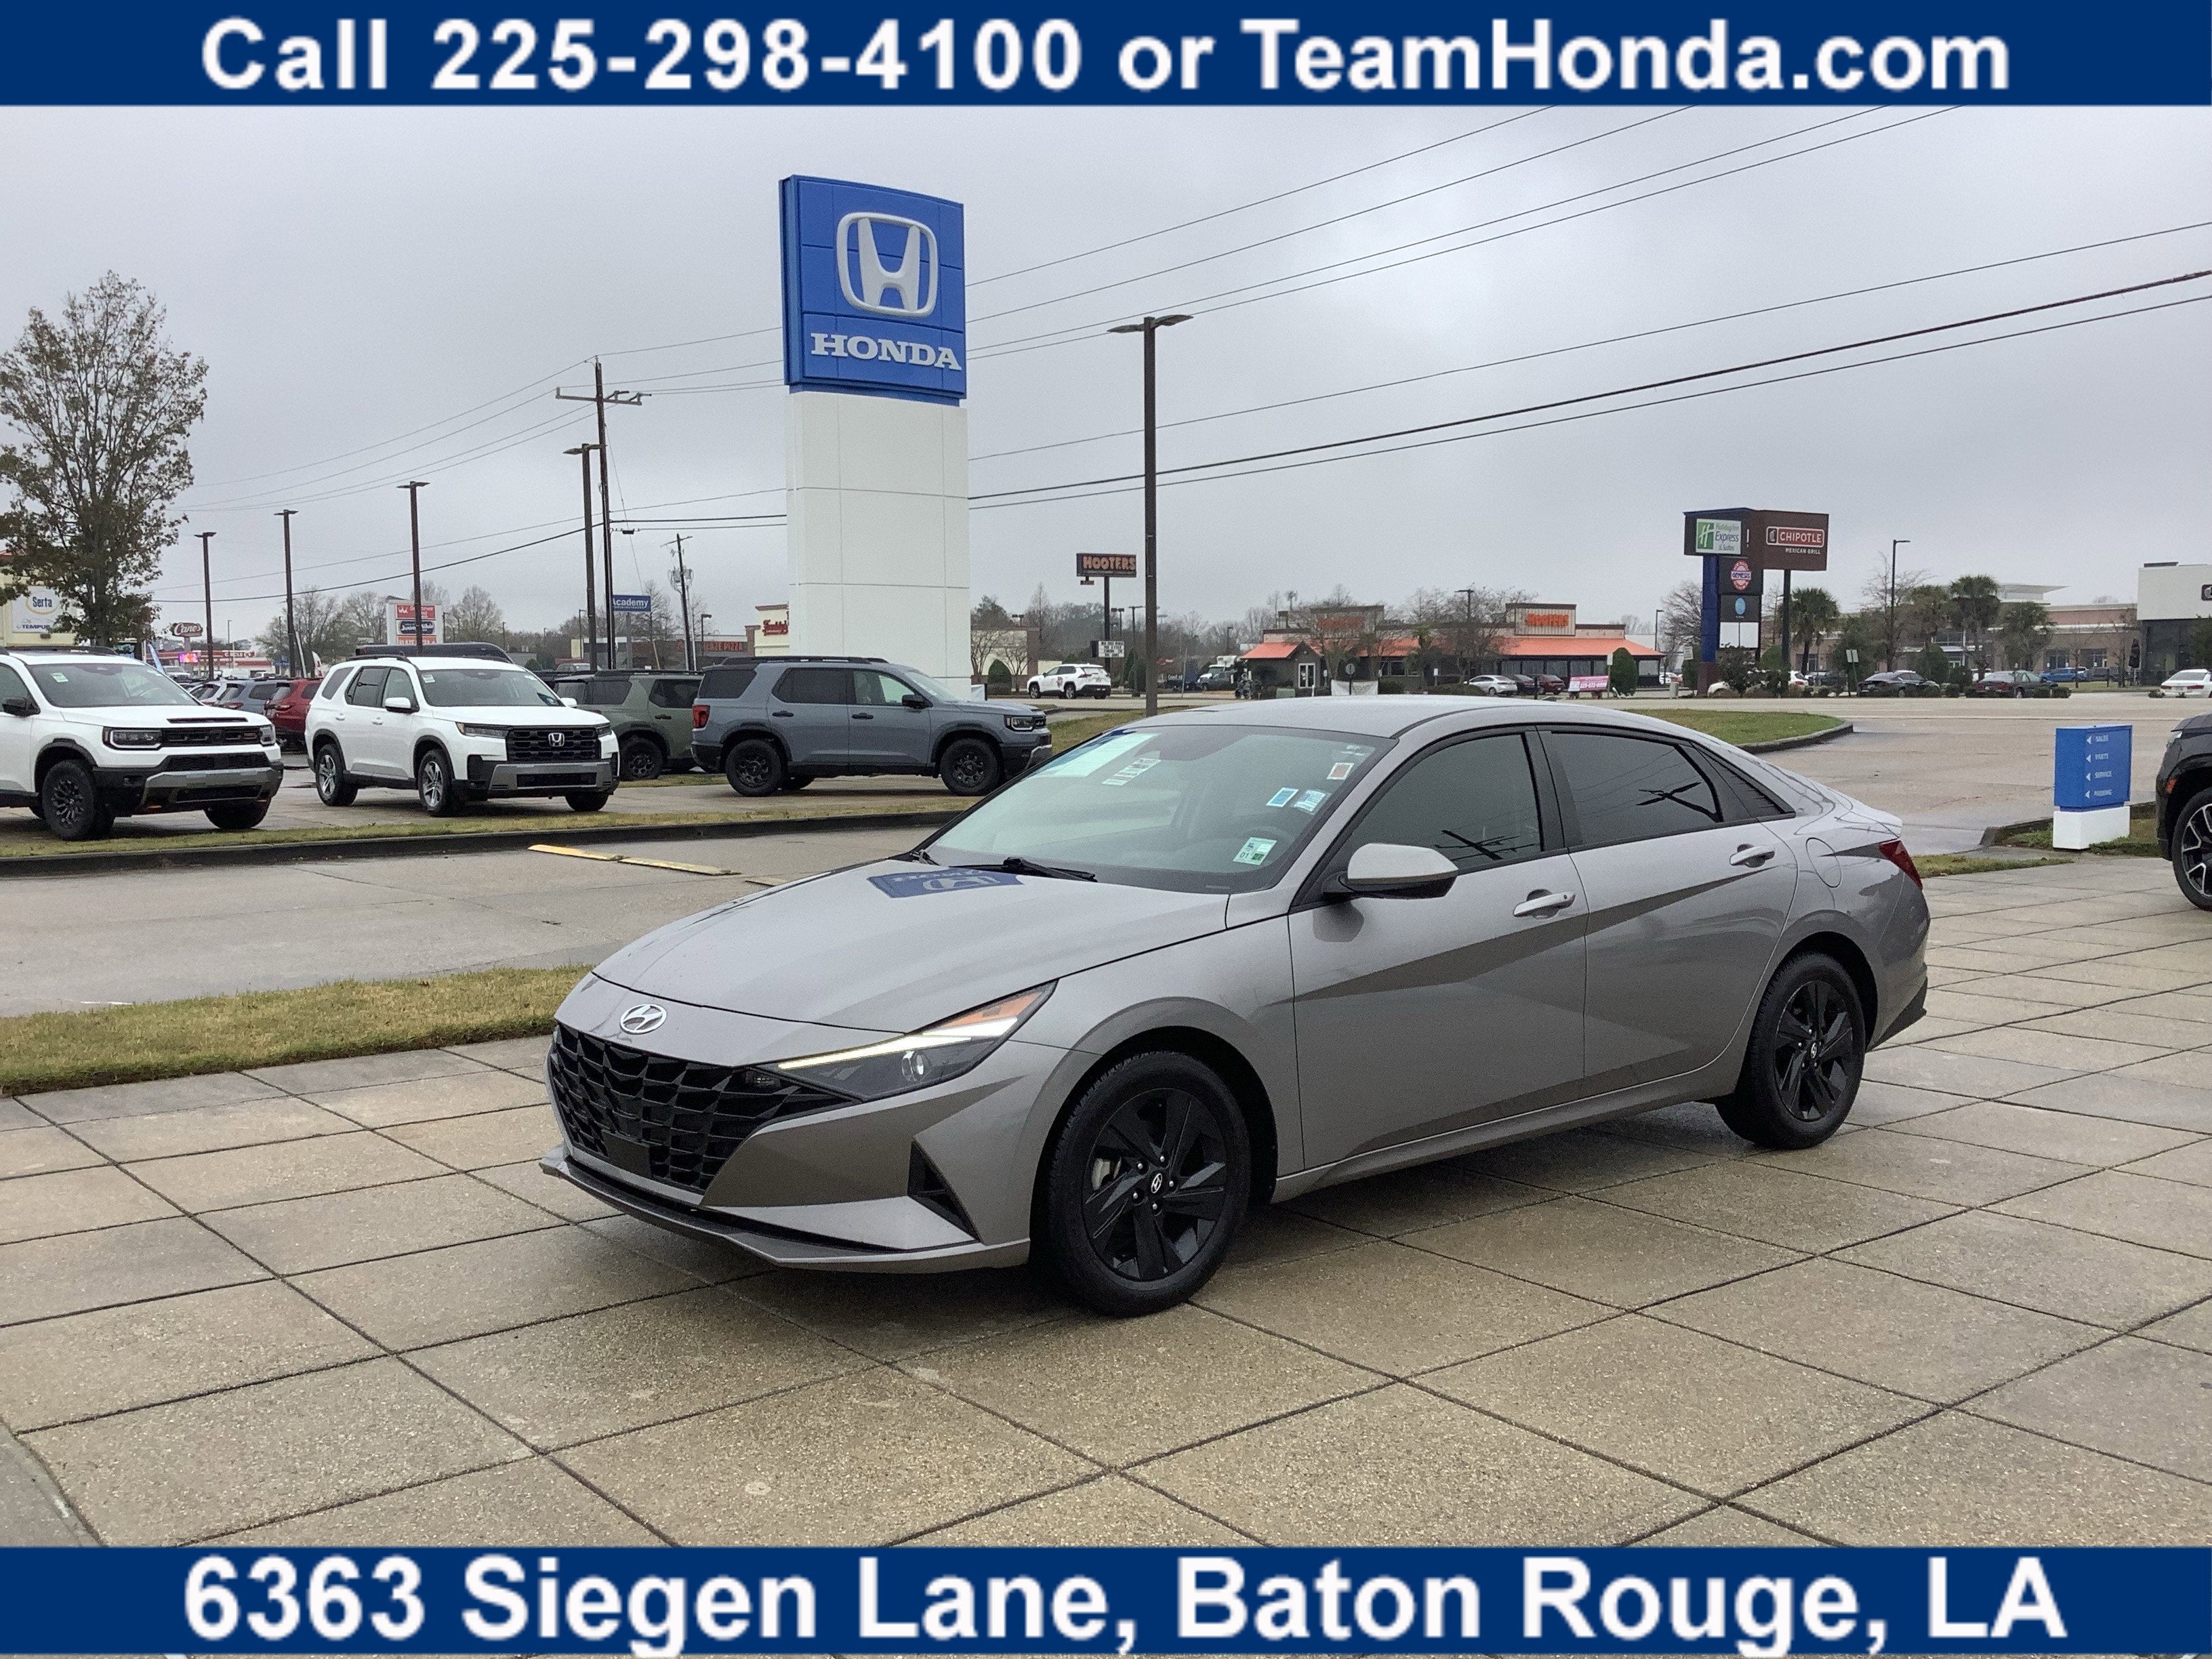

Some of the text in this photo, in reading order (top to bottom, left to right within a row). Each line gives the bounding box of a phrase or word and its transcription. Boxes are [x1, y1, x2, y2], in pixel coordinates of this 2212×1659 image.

[811, 333, 962, 371] HONDA
[1715, 531, 1740, 543] Express
[1779, 531, 1822, 543] CHIPOTLE
[1082, 555, 1136, 571] HOOTERS
[32, 596, 53, 608] Serta
[2095, 735, 2109, 743] SALES
[2094, 771, 2112, 779] SERVICE
